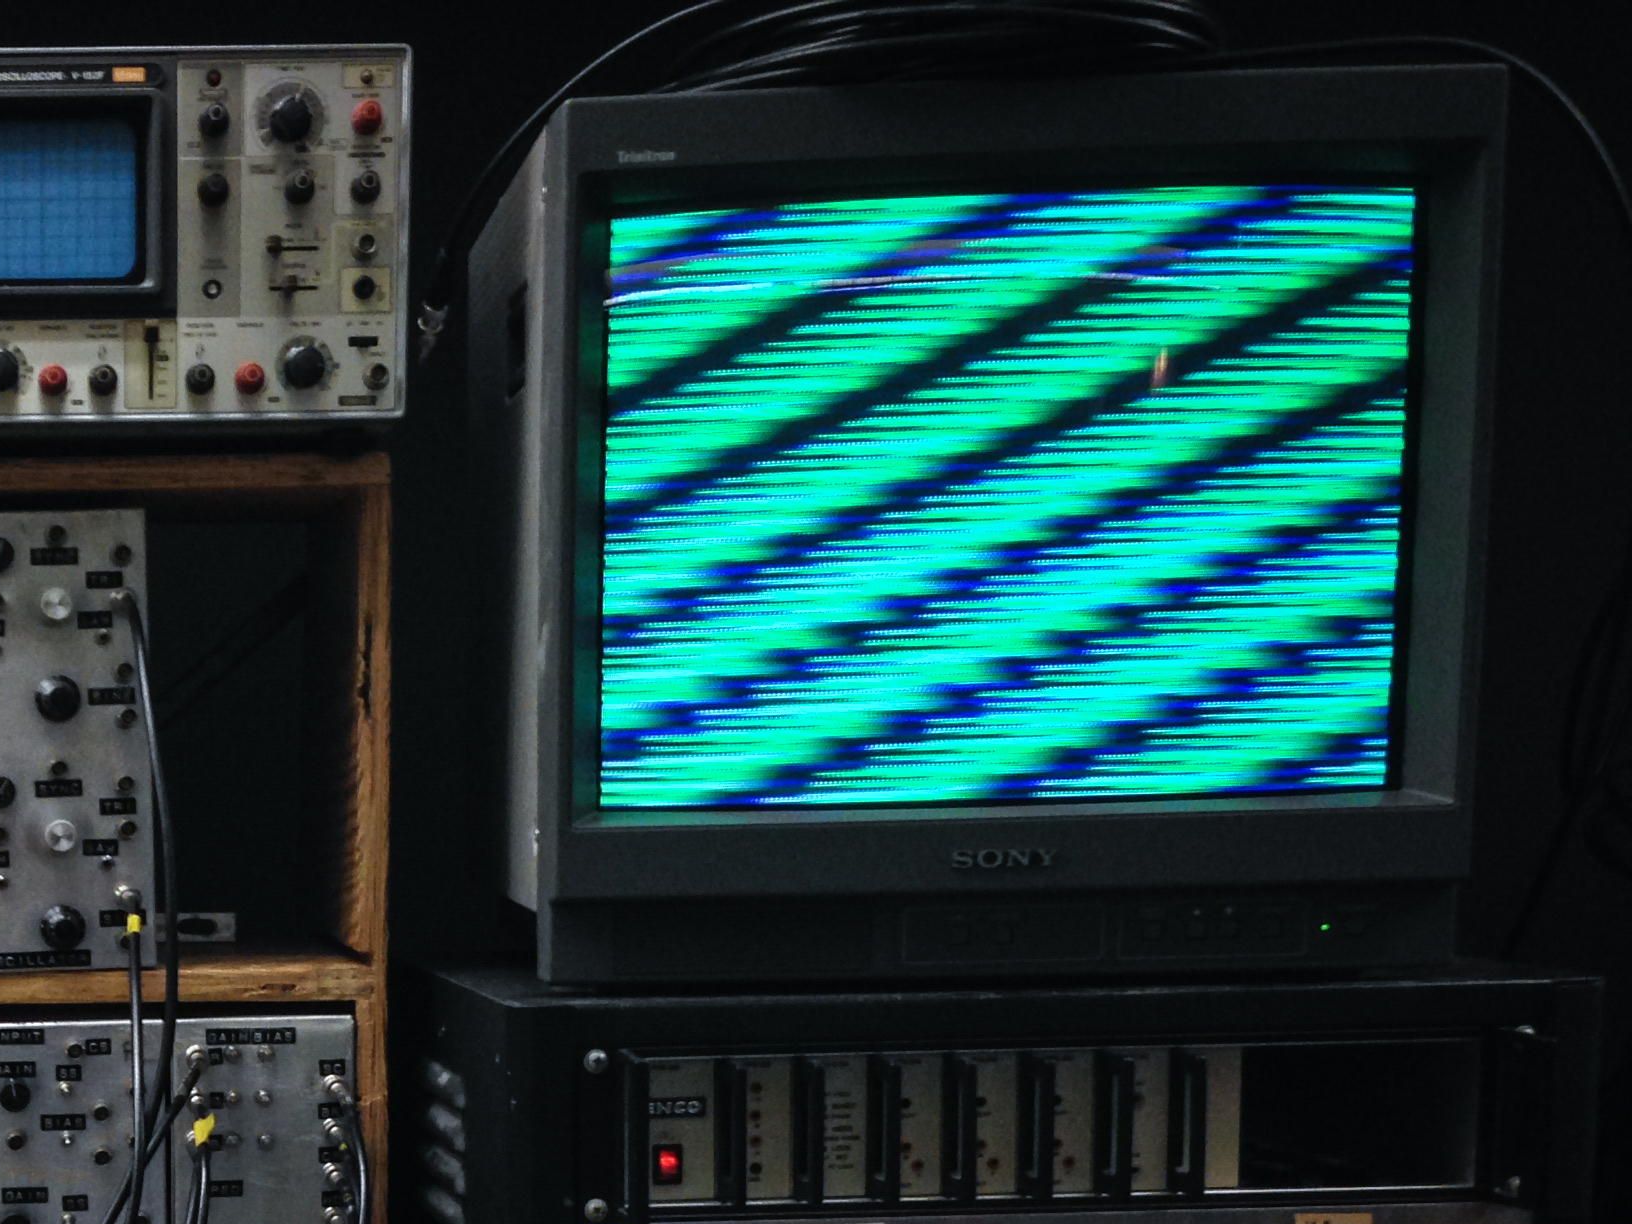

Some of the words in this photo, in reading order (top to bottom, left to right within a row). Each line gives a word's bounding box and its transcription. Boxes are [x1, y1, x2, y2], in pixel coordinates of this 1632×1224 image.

[951, 849, 1057, 868] SONY
[207, 1032, 249, 1043] GAIN
[253, 1032, 293, 1043] BIAS
[649, 1100, 704, 1114] ENCO
